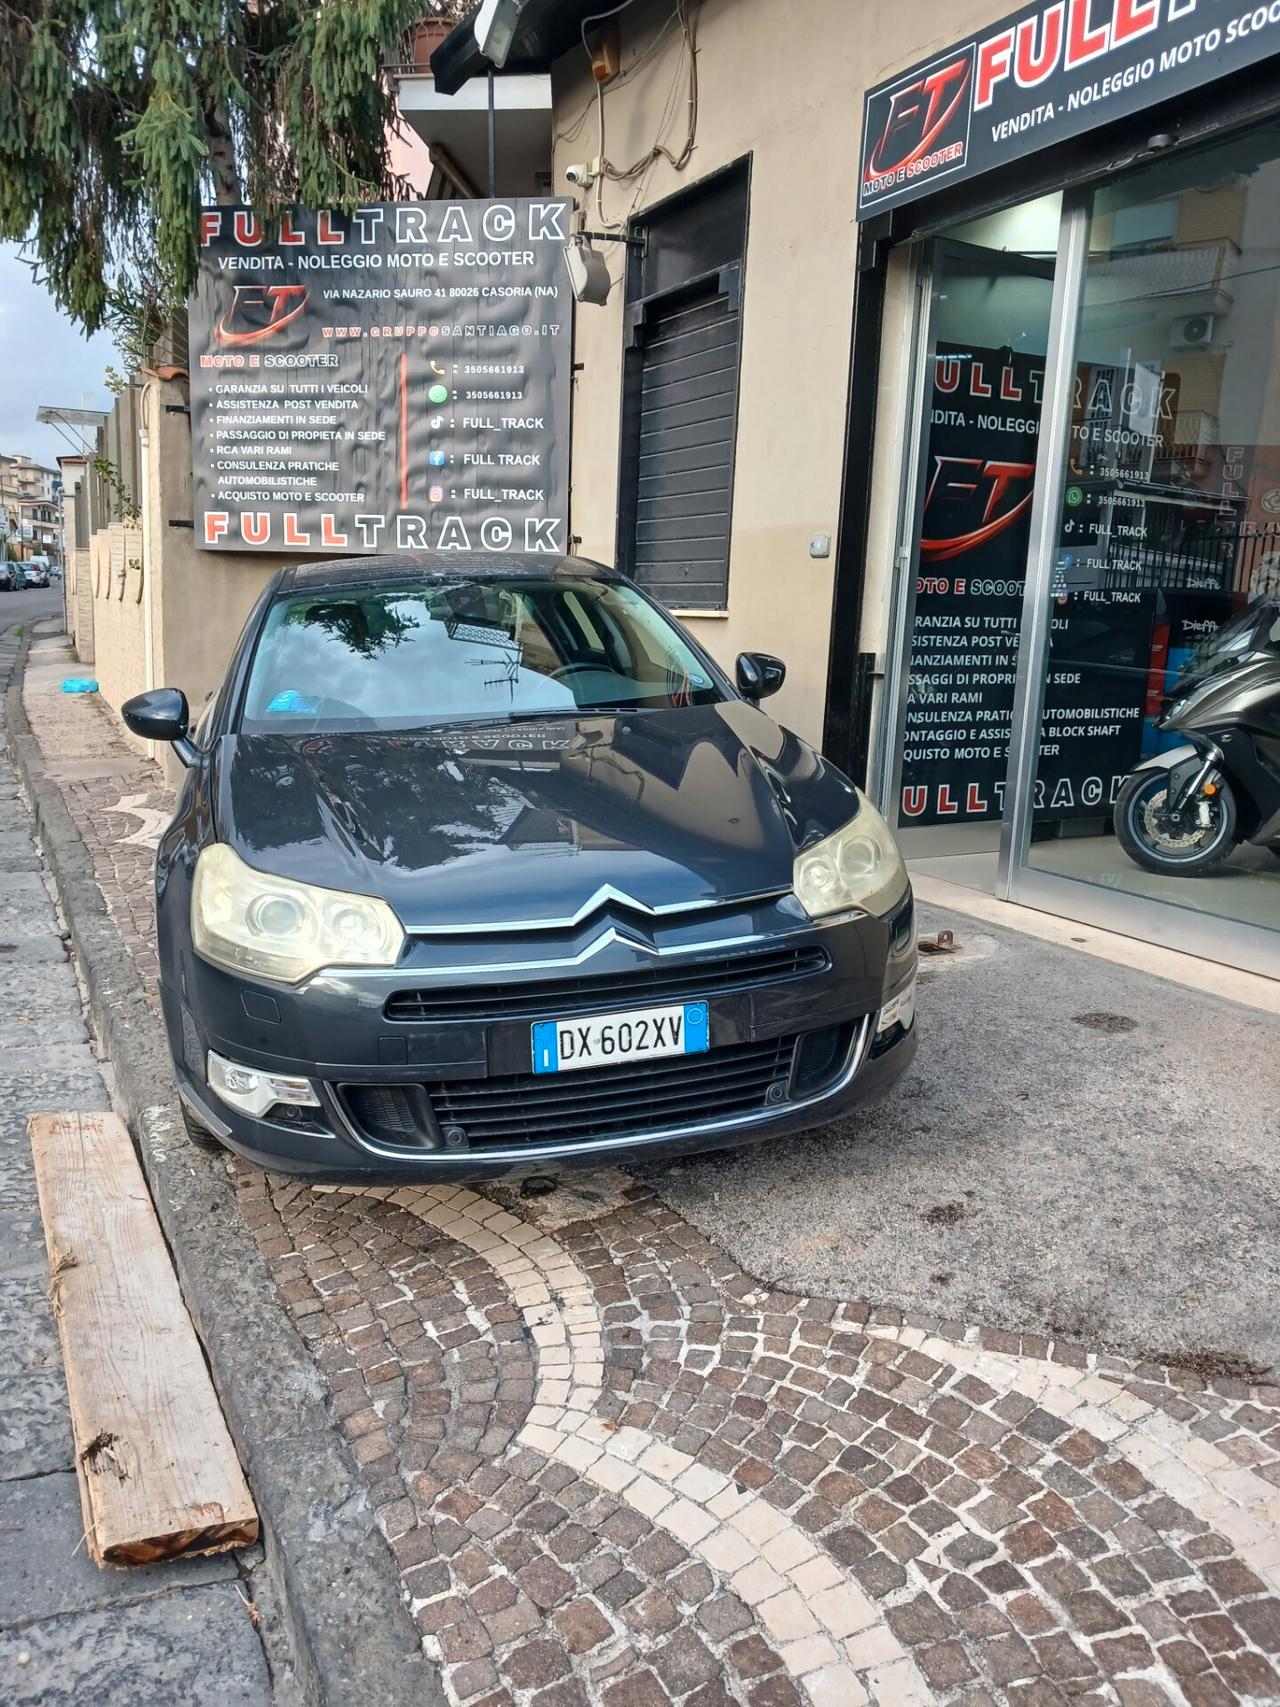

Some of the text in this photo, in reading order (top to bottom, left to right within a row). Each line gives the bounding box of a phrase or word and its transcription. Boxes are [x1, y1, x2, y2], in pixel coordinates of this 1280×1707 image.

[992, 102, 1054, 142] VENDITA
[1067, 58, 1154, 111] NOLEGGIO
[1159, 28, 1221, 72] MOTO
[1225, 1, 1280, 43] SCOO
[862, 141, 964, 196] MOTO E SCOOTER
[218, 256, 284, 270] VENDITA
[298, 253, 382, 270] NOLEGGIO
[387, 253, 434, 268] MOTO
[439, 253, 449, 267] E
[453, 251, 534, 267] SCOOTER
[323, 286, 558, 299] VIA NAZARIO SAURO 41 80026 CASORIA (NA)
[321, 324, 560, 337] WWW.GRUPPOSANTIAGO.IT
[200, 354, 339, 368] MOTO E SCOOTER
[464, 365, 525, 374] 3505661913
[216, 384, 268, 393] GARANZIA
[270, 385, 284, 393] SU
[289, 385, 318, 393] TUTTI
[327, 384, 368, 393] VEICOLI
[465, 391, 523, 400] 3505661913
[216, 400, 359, 409] ASSISTENZA POST VENDITA
[216, 416, 337, 424] FINANZIAMENTI IN SEDE
[463, 418, 544, 431] FULL_TRACK
[931, 409, 966, 427] DITA
[977, 414, 1040, 434] NOLEGGI
[1072, 425, 1089, 440] TO
[1093, 428, 1101, 441] E
[1104, 429, 1164, 447] SCOOTER
[216, 431, 386, 440] PASSAGGIO DI PROPIETA IN SEDE
[216, 446, 292, 455] RCA VARI RAMI
[217, 461, 339, 471] CONSULENZA PRATICHE
[463, 453, 495, 465] FULL
[498, 454, 541, 466] TRACK
[1100, 467, 1150, 480] 3505661913
[217, 476, 317, 486] AUTOMOBILISTICHE
[217, 491, 365, 502] ACQUISTO MOTO E SCOOTER
[464, 488, 544, 502] FULL_TRACK
[1089, 523, 1148, 538] FULL_TRACK
[1087, 558, 1109, 569] FULL
[1112, 560, 1142, 571] TRACK
[916, 577, 1025, 596] OTO E SCOOT
[1083, 591, 1141, 604] FULL_TRACK
[915, 616, 1017, 628] RANZIA SU TUTTI
[912, 635, 968, 647] SISTENZA
[971, 636, 1002, 647] POST
[910, 655, 991, 666] ANZIAMENTI
[995, 655, 1008, 665] IN
[909, 674, 952, 685] SSAGGI
[957, 674, 969, 684] DI
[972, 673, 1016, 684] PROPRI
[1054, 673, 1081, 684] SEDE
[918, 693, 948, 704] VARI
[951, 692, 983, 703] RAMI
[907, 708, 1140, 723] NSULENZA PRATI UTOMOBILISTICHE
[903, 729, 966, 742] ONTAGGIO
[970, 729, 976, 739] E
[1048, 726, 1085, 737] BLOCK
[1087, 725, 1121, 736] SHAFT
[903, 749, 949, 762] QUISTO
[954, 747, 990, 759] MOTO
[993, 747, 1001, 757] E
[543, 1015, 682, 1067] I DX 602XV
